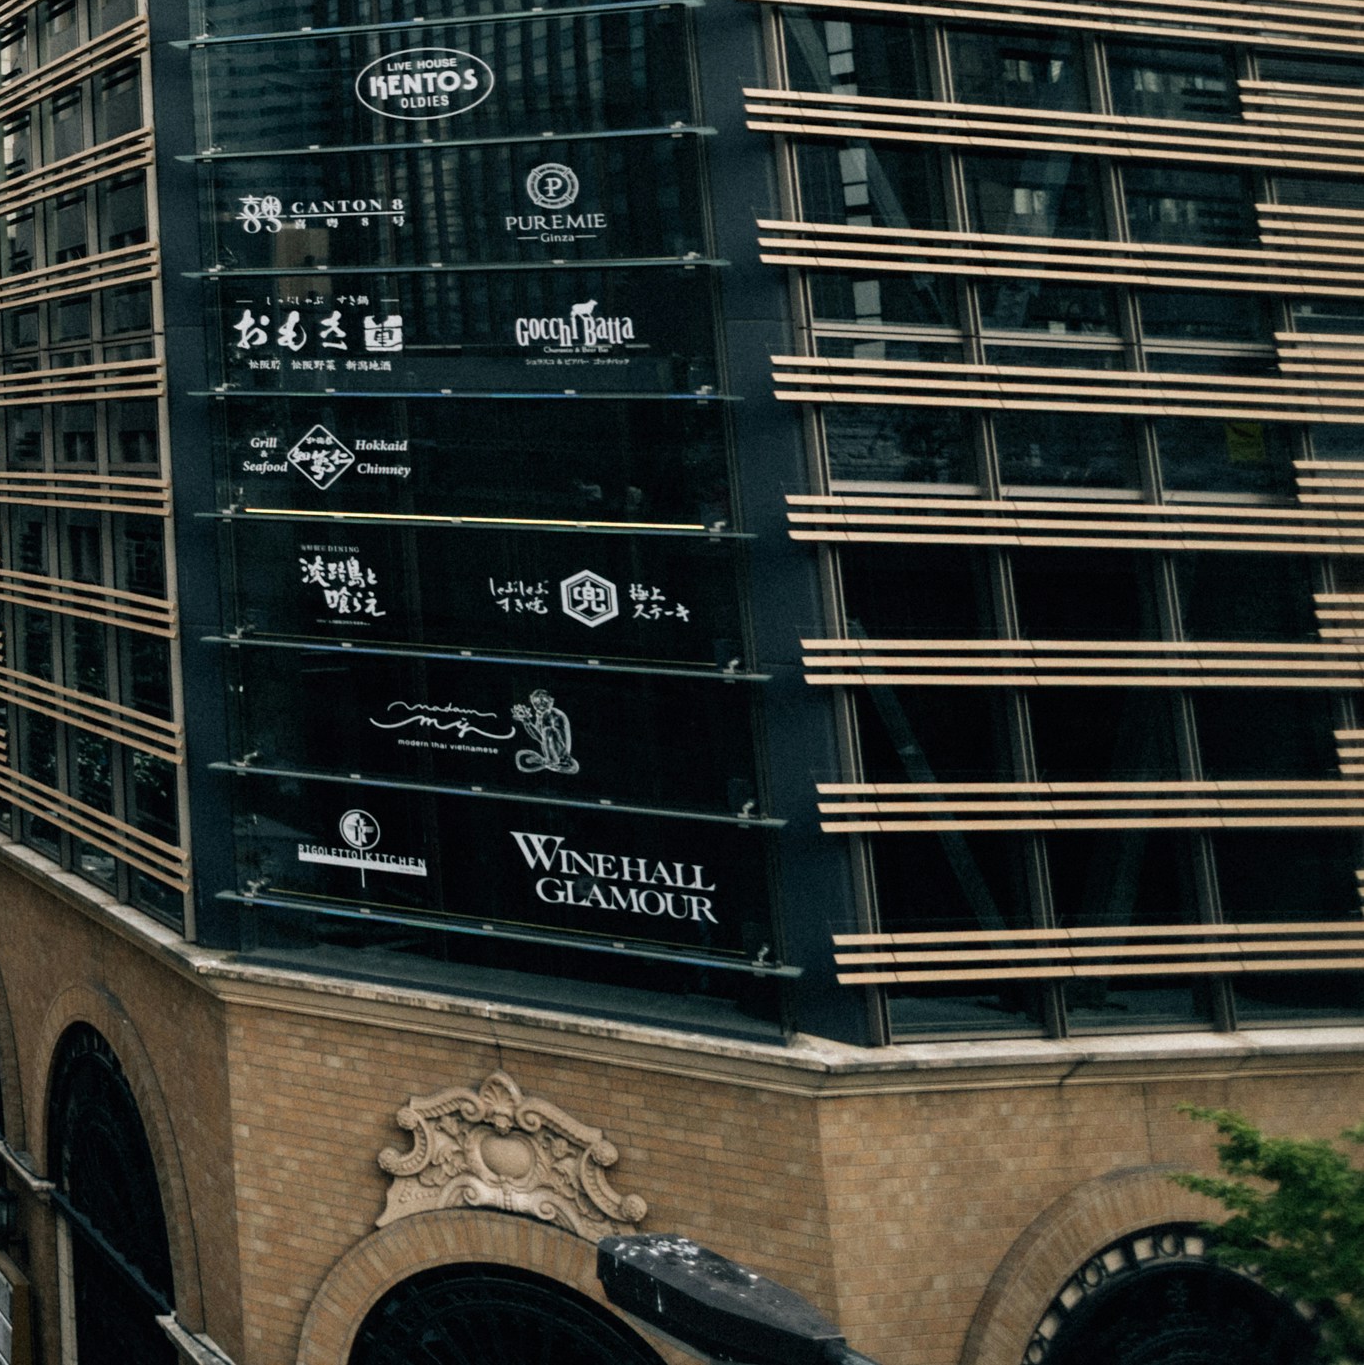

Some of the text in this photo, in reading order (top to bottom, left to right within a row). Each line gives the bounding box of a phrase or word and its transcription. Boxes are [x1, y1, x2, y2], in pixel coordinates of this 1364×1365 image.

[387, 57, 458, 72] LIVE HOUSE
[369, 68, 478, 100] KENTOS
[400, 94, 450, 109] OLDIES
[291, 198, 404, 214] CANTON 8
[505, 213, 608, 231] PUREMIE
[540, 232, 575, 244] Ginza
[250, 437, 278, 449] Grill
[260, 450, 268, 458] &
[242, 461, 288, 473] Seafood
[357, 463, 411, 478] Chimney
[327, 545, 360, 553] DINING
[632, 602, 691, 623] ステーキ
[397, 738, 499, 754] modern thai vietnamese
[297, 843, 427, 869] RIGOLETTO KITCHEN
[535, 877, 720, 924] GLAMOUR
